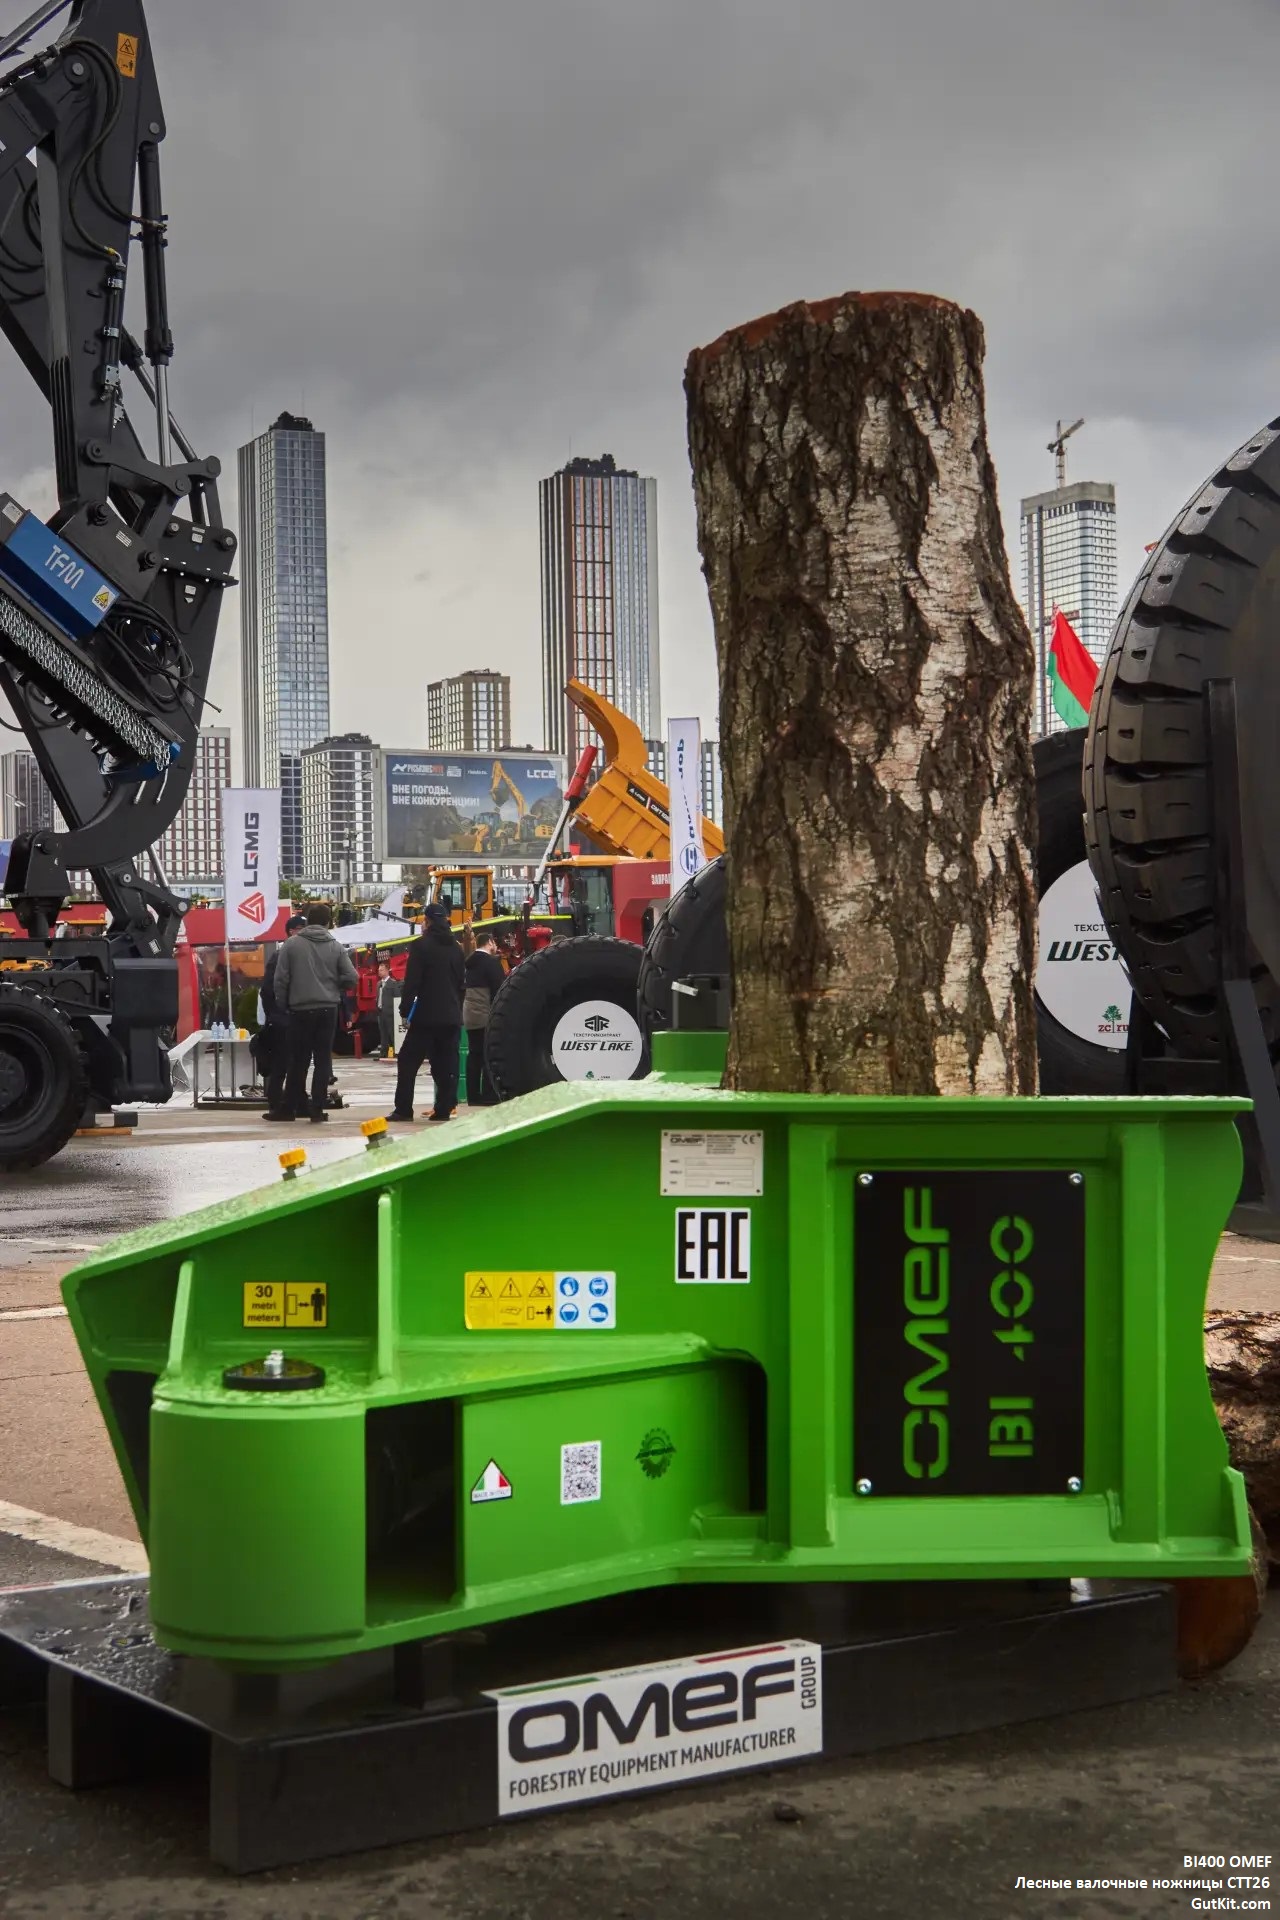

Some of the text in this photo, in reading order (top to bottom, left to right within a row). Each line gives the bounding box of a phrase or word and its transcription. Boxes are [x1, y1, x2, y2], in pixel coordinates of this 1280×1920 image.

[44, 544, 84, 590] TFM
[392, 784, 410, 794] ВНЕ
[392, 796, 410, 804] ВНЕ
[244, 812, 259, 887] LGMG
[560, 1040, 598, 1051] WEST
[678, 1212, 748, 1279] EAC
[255, 1285, 273, 1298] 30
[989, 1215, 1034, 1456] BI 400
[801, 1656, 816, 1710] GROUP
[509, 1727, 796, 1799] FORESTRY EQUIPMENT MANUFACTURER
